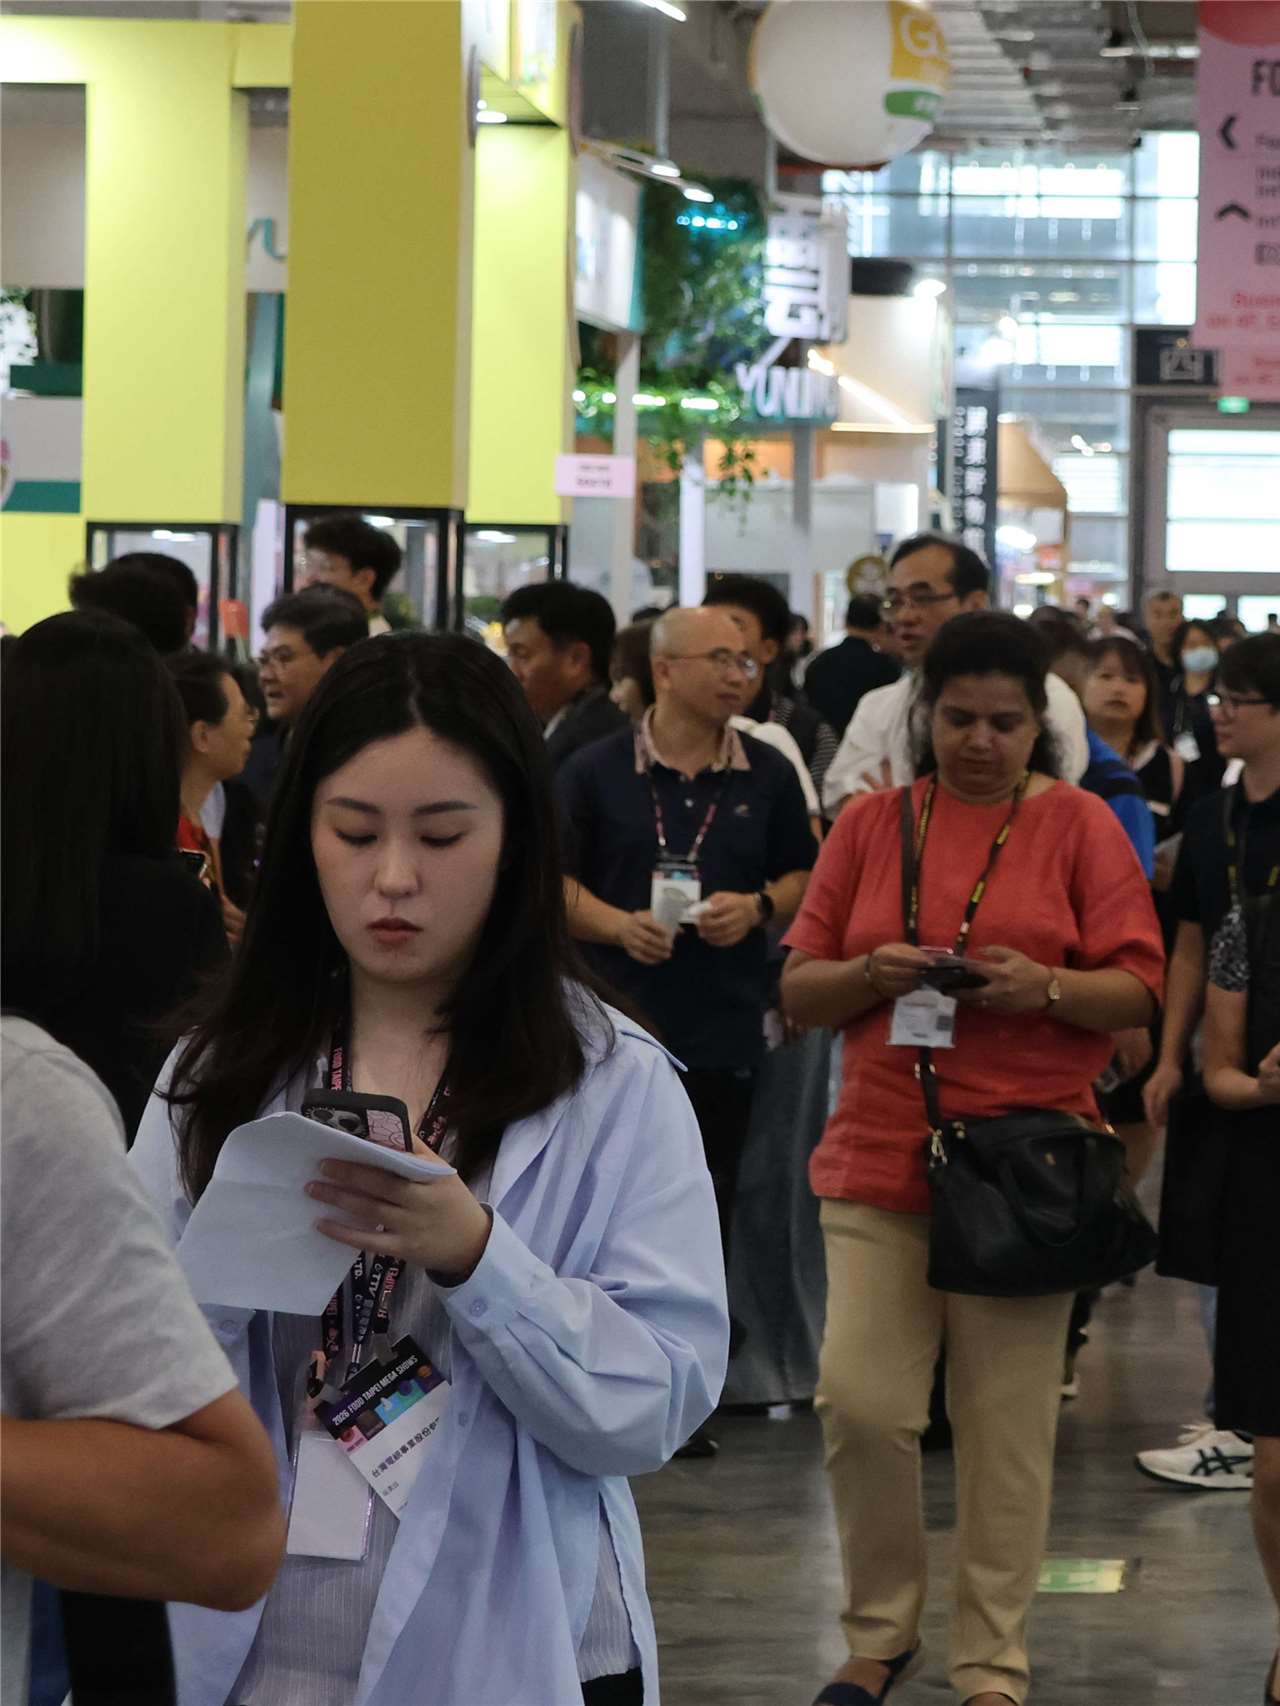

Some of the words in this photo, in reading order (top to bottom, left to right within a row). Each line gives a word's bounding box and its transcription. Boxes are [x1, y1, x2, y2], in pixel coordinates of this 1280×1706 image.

[332, 1410, 351, 1426] 2026
[349, 1397, 366, 1414] FOOD
[362, 1382, 383, 1403] TAIPEI
[379, 1370, 400, 1389] MEGA
[396, 1354, 418, 1374] SHOWS
